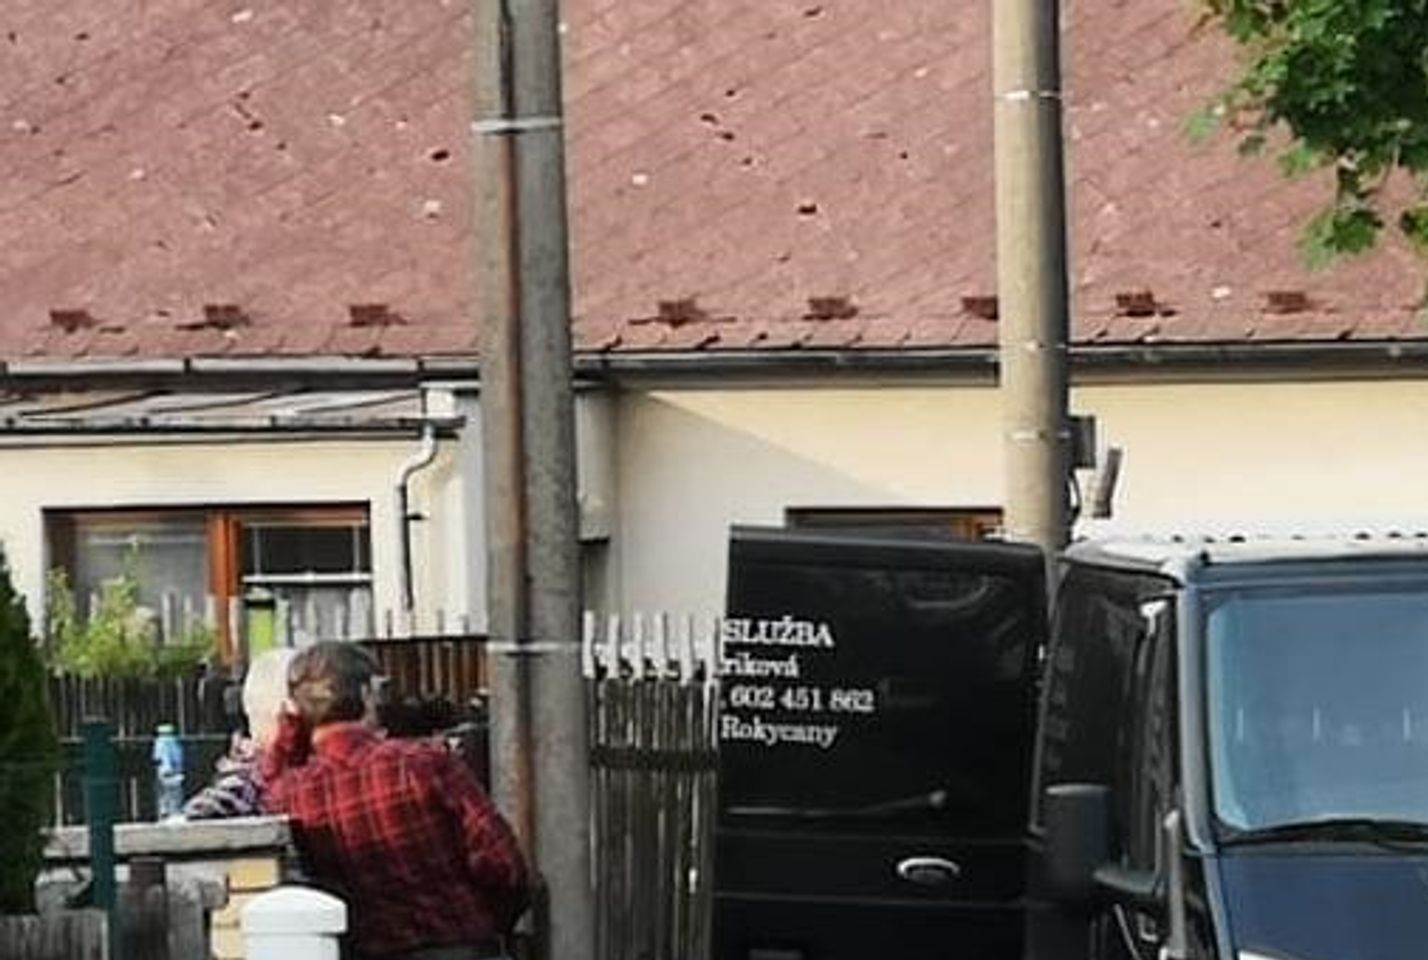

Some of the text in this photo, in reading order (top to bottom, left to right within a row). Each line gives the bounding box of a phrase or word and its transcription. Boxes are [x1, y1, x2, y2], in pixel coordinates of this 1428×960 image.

[723, 615, 835, 647] SLUŽBA
[730, 686, 775, 709] 602
[780, 687, 822, 711] 451
[721, 714, 838, 748] Rokycany
